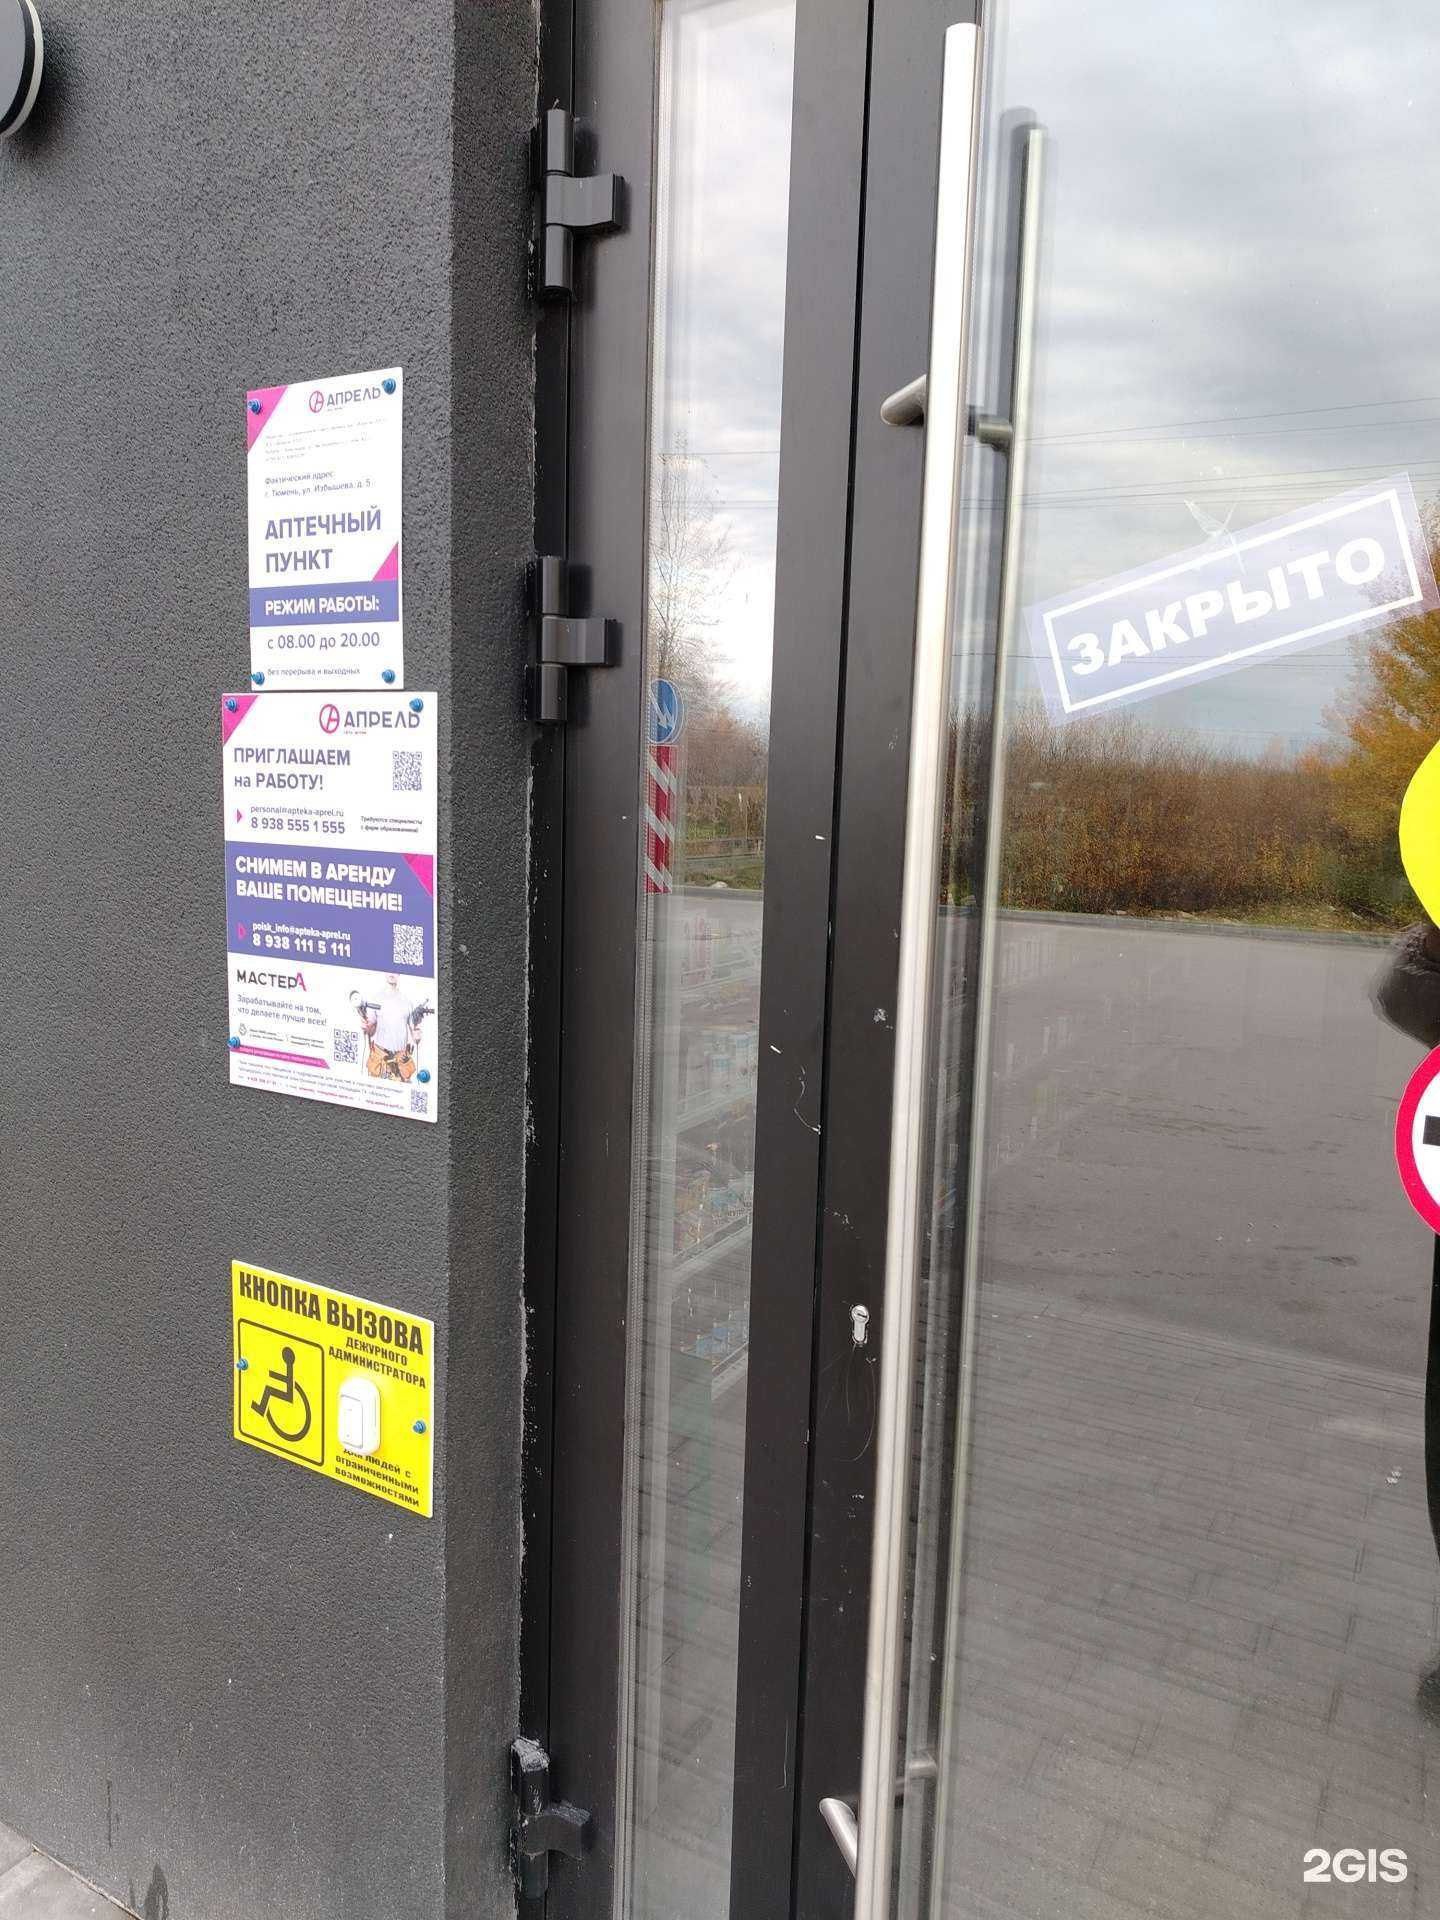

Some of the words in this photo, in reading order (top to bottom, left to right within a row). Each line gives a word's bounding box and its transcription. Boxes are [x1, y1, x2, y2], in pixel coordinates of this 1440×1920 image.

[327, 387, 381, 406] АПРЕЛЬ
[265, 505, 381, 540] АПТЕЧНЫЙ
[265, 548, 333, 573] ПУНКТ
[265, 598, 315, 616] РЕЖИМ
[319, 595, 380, 614] РАБОТЫ:
[1067, 537, 1385, 676] ЗАКРЫТО
[267, 638, 274, 649] с
[277, 634, 316, 649] 08.00
[320, 637, 336, 651] до
[340, 632, 380, 648] 20.00
[281, 668, 316, 677] перерыва
[317, 668, 322, 676] и
[323, 667, 360, 676] выходных
[343, 710, 420, 728] АПРЕЛЬ
[234, 747, 351, 766] ПРИГЛАШАЕМ
[234, 775, 250, 788] на
[256, 772, 324, 791] РАБОТУ!
[251, 817, 258, 829] 8
[262, 818, 283, 830] 938
[287, 819, 309, 832] 555
[313, 820, 318, 832] 1
[322, 821, 345, 834] 555
[235, 855, 307, 878] СНИМЕМ
[311, 861, 322, 879] В
[325, 863, 396, 887] АРЕНДУ
[236, 879, 283, 900] ВАШЕ
[287, 884, 403, 912] ПОМЕЩЕНИЕ!
[252, 933, 261, 947] 8
[265, 934, 290, 950] 938
[294, 938, 314, 953] 111
[318, 940, 326, 954] 5
[331, 943, 351, 958] 111
[236, 969, 307, 992] МАСТЕРА
[237, 994, 294, 1010] Зарабатывайте
[295, 1003, 304, 1012] на
[237, 1007, 250, 1015] что
[251, 1009, 280, 1019] делаете
[282, 1013, 306, 1023] лучше
[308, 1017, 327, 1027] всех!
[239, 1271, 322, 1322] КНОПКА
[326, 1298, 424, 1356] ВЫЗОВА
[345, 1336, 408, 1366] ДЕЖУРНОГО
[329, 1346, 426, 1389] АДМИНИСТРАТОРА
[335, 1455, 419, 1495] ограниченными
[365, 1455, 401, 1475] людей
[335, 1467, 419, 1507] возможностями
